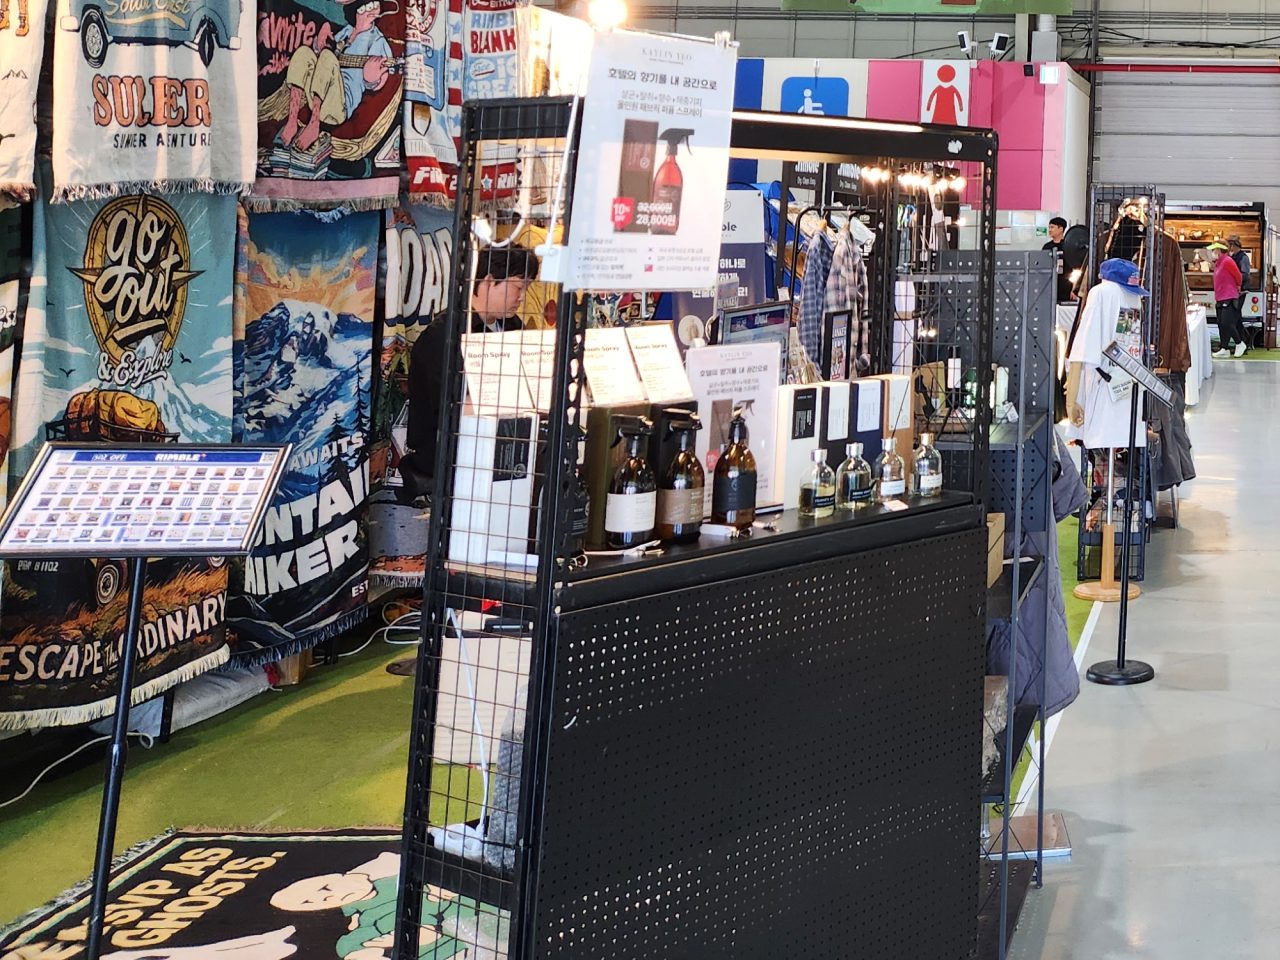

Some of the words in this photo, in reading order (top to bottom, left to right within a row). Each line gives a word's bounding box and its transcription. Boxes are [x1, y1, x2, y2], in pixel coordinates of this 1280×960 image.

[608, 67, 637, 81] 호텔의
[640, 71, 667, 84] 향기를
[670, 76, 680, 86] 내
[682, 77, 718, 90] 공간으로
[94, 208, 167, 304] go
[114, 241, 183, 324] out
[97, 352, 113, 381] &
[113, 341, 173, 389] Explore
[154, 452, 201, 462] RIMBLE
[109, 850, 288, 948] GHOSTS.
